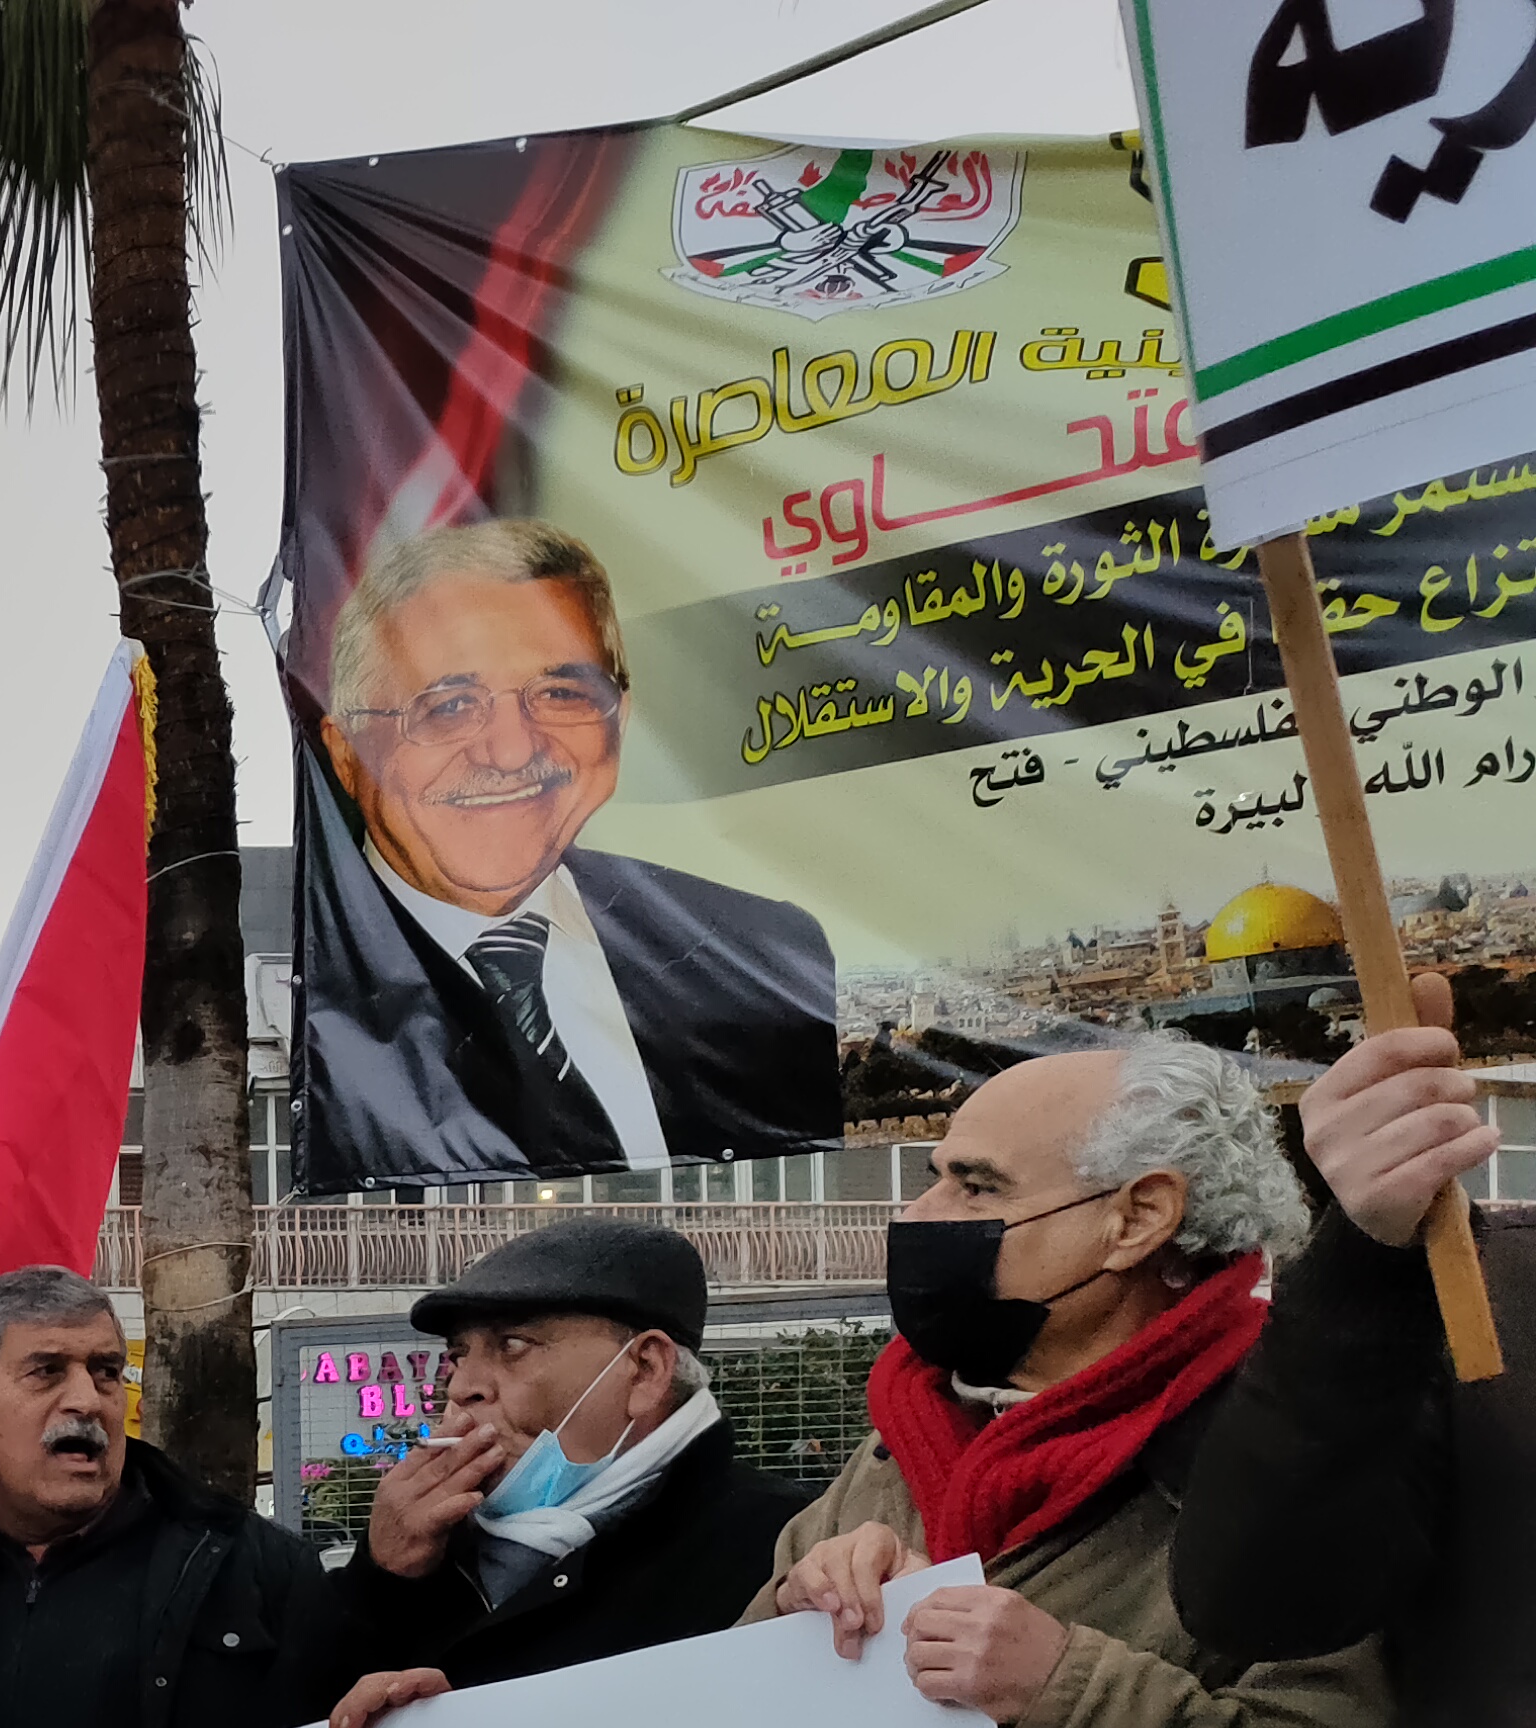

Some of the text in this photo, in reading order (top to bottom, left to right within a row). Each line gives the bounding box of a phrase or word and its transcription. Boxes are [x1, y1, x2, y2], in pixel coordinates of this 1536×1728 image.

[613, 329, 998, 488] المعاصرة
[1041, 516, 1180, 602] الثورة
[756, 560, 1026, 667] والمقاومة
[1174, 600, 1246, 689] في
[991, 621, 1154, 711] الحرية
[1349, 656, 1523, 744] الوطني
[969, 746, 1047, 807] فتح
[1094, 696, 1300, 788] فلسطيني
[1463, 736, 1536, 788] رام
